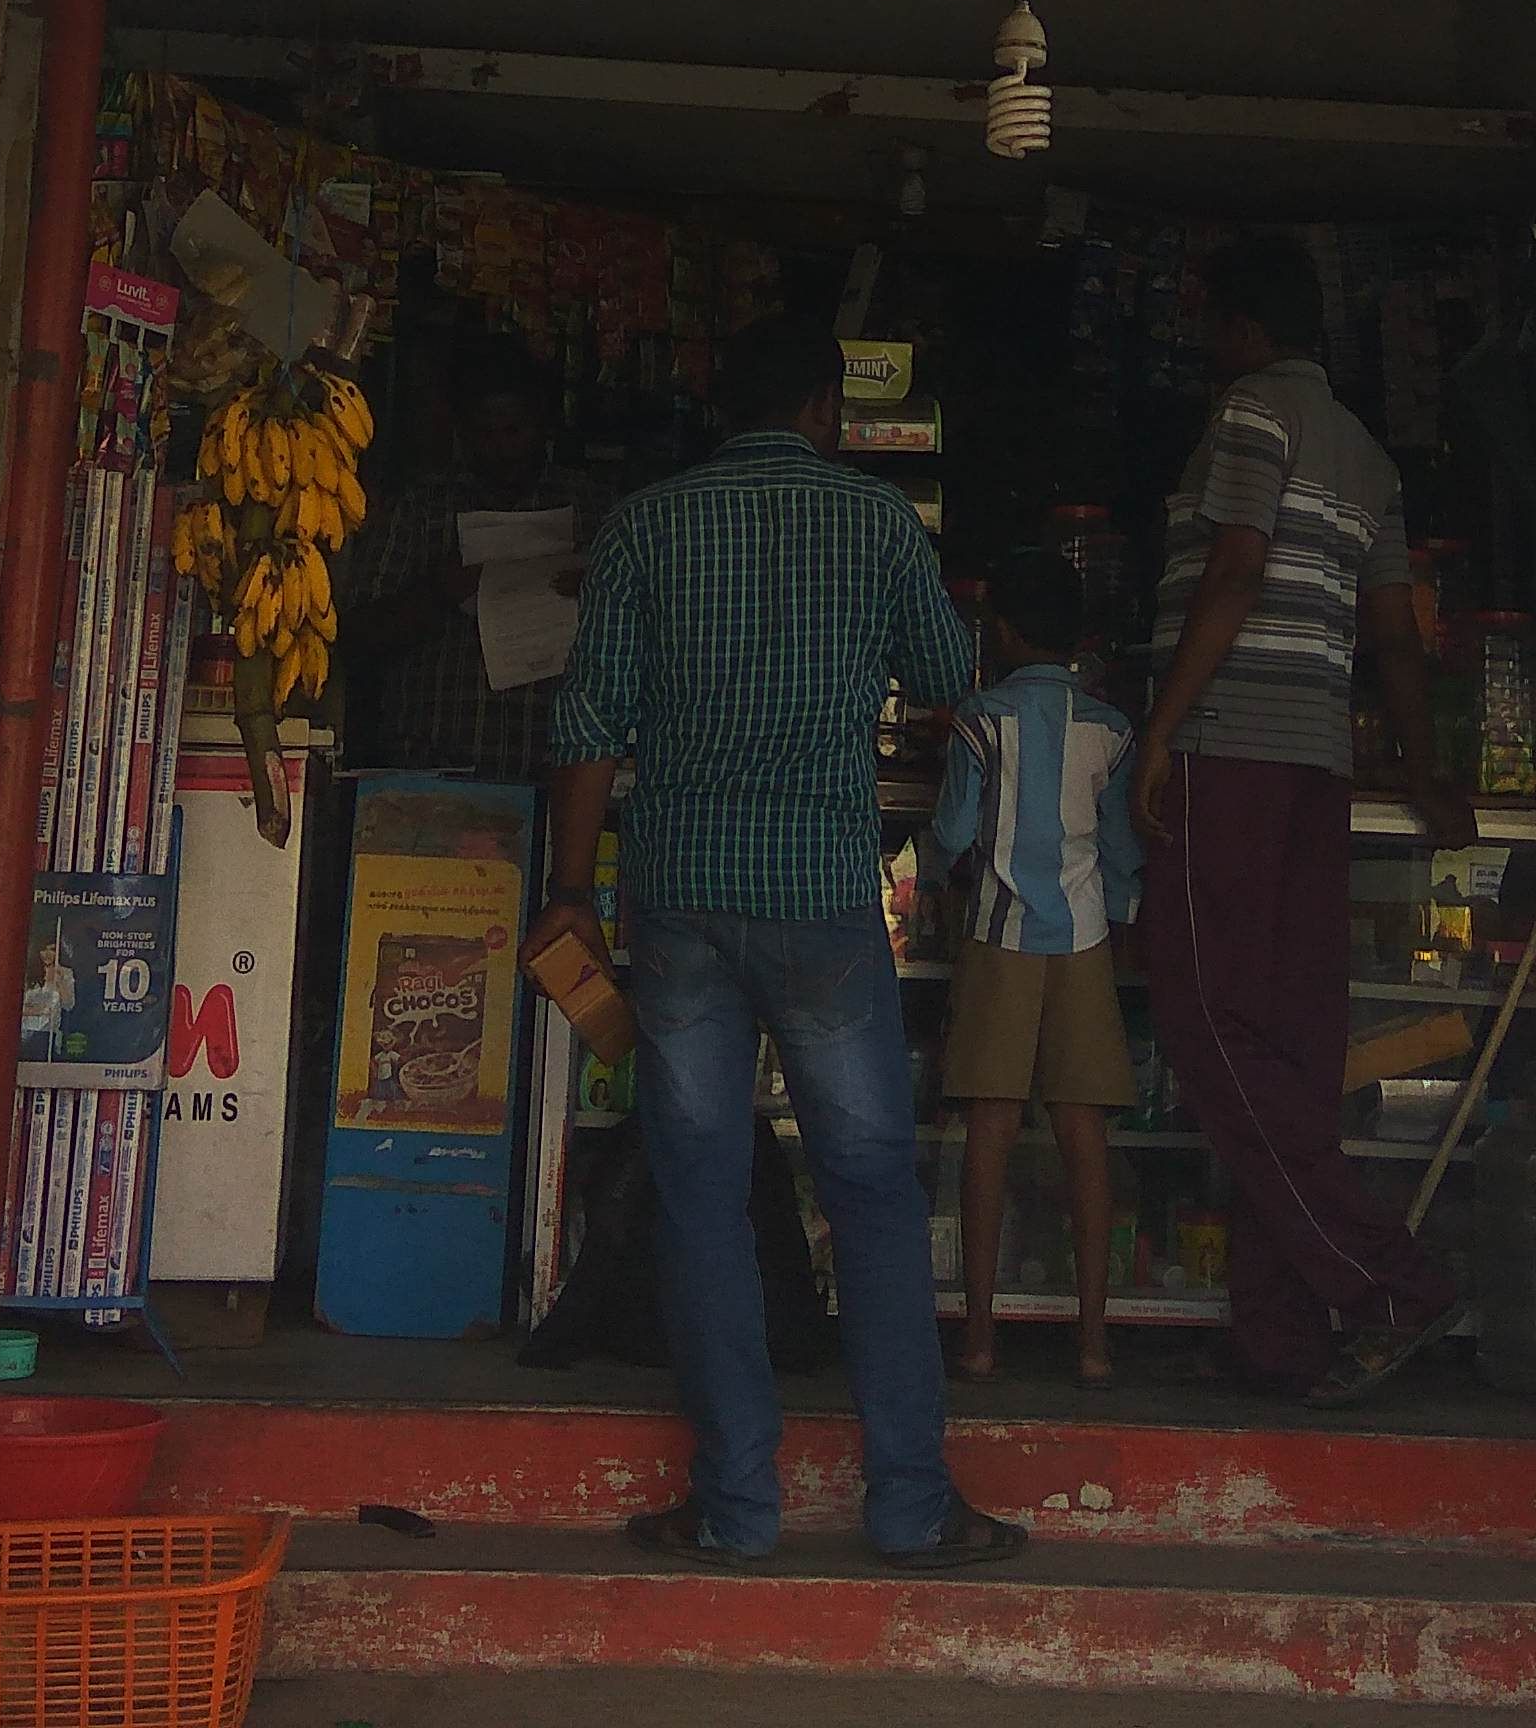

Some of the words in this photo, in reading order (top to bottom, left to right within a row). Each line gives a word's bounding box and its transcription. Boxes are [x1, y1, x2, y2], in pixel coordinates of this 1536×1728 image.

[34, 889, 80, 908] Philips
[82, 891, 131, 907] Lifemax
[97, 940, 156, 950] BRIGHTNESS
[116, 949, 135, 957] FOR
[97, 958, 151, 1001] 10
[102, 1002, 143, 1013] YEARS
[388, 990, 474, 1015] CHOCOS
[105, 1068, 147, 1079] PHILIPS
[92, 1194, 111, 1257] Lifemax
